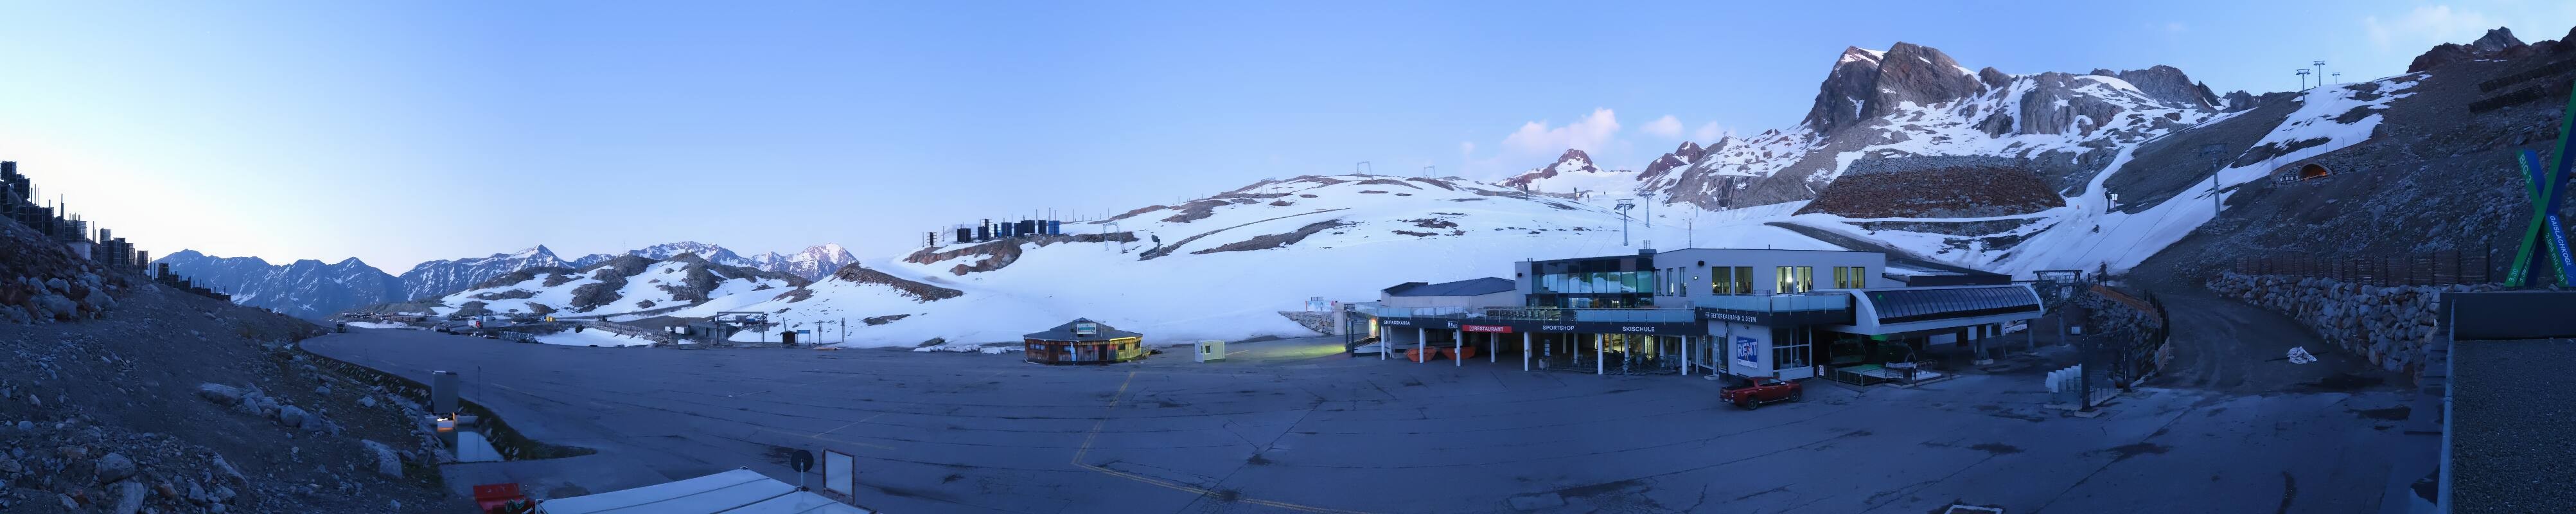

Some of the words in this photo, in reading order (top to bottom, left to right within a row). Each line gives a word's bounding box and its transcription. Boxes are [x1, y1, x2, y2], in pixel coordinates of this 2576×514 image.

[2519, 154, 2528, 175] BIG
[2526, 175, 2532, 184] 3
[2550, 215, 2572, 266] GAISLACHKOGL
[1737, 341, 1757, 357] RENT
